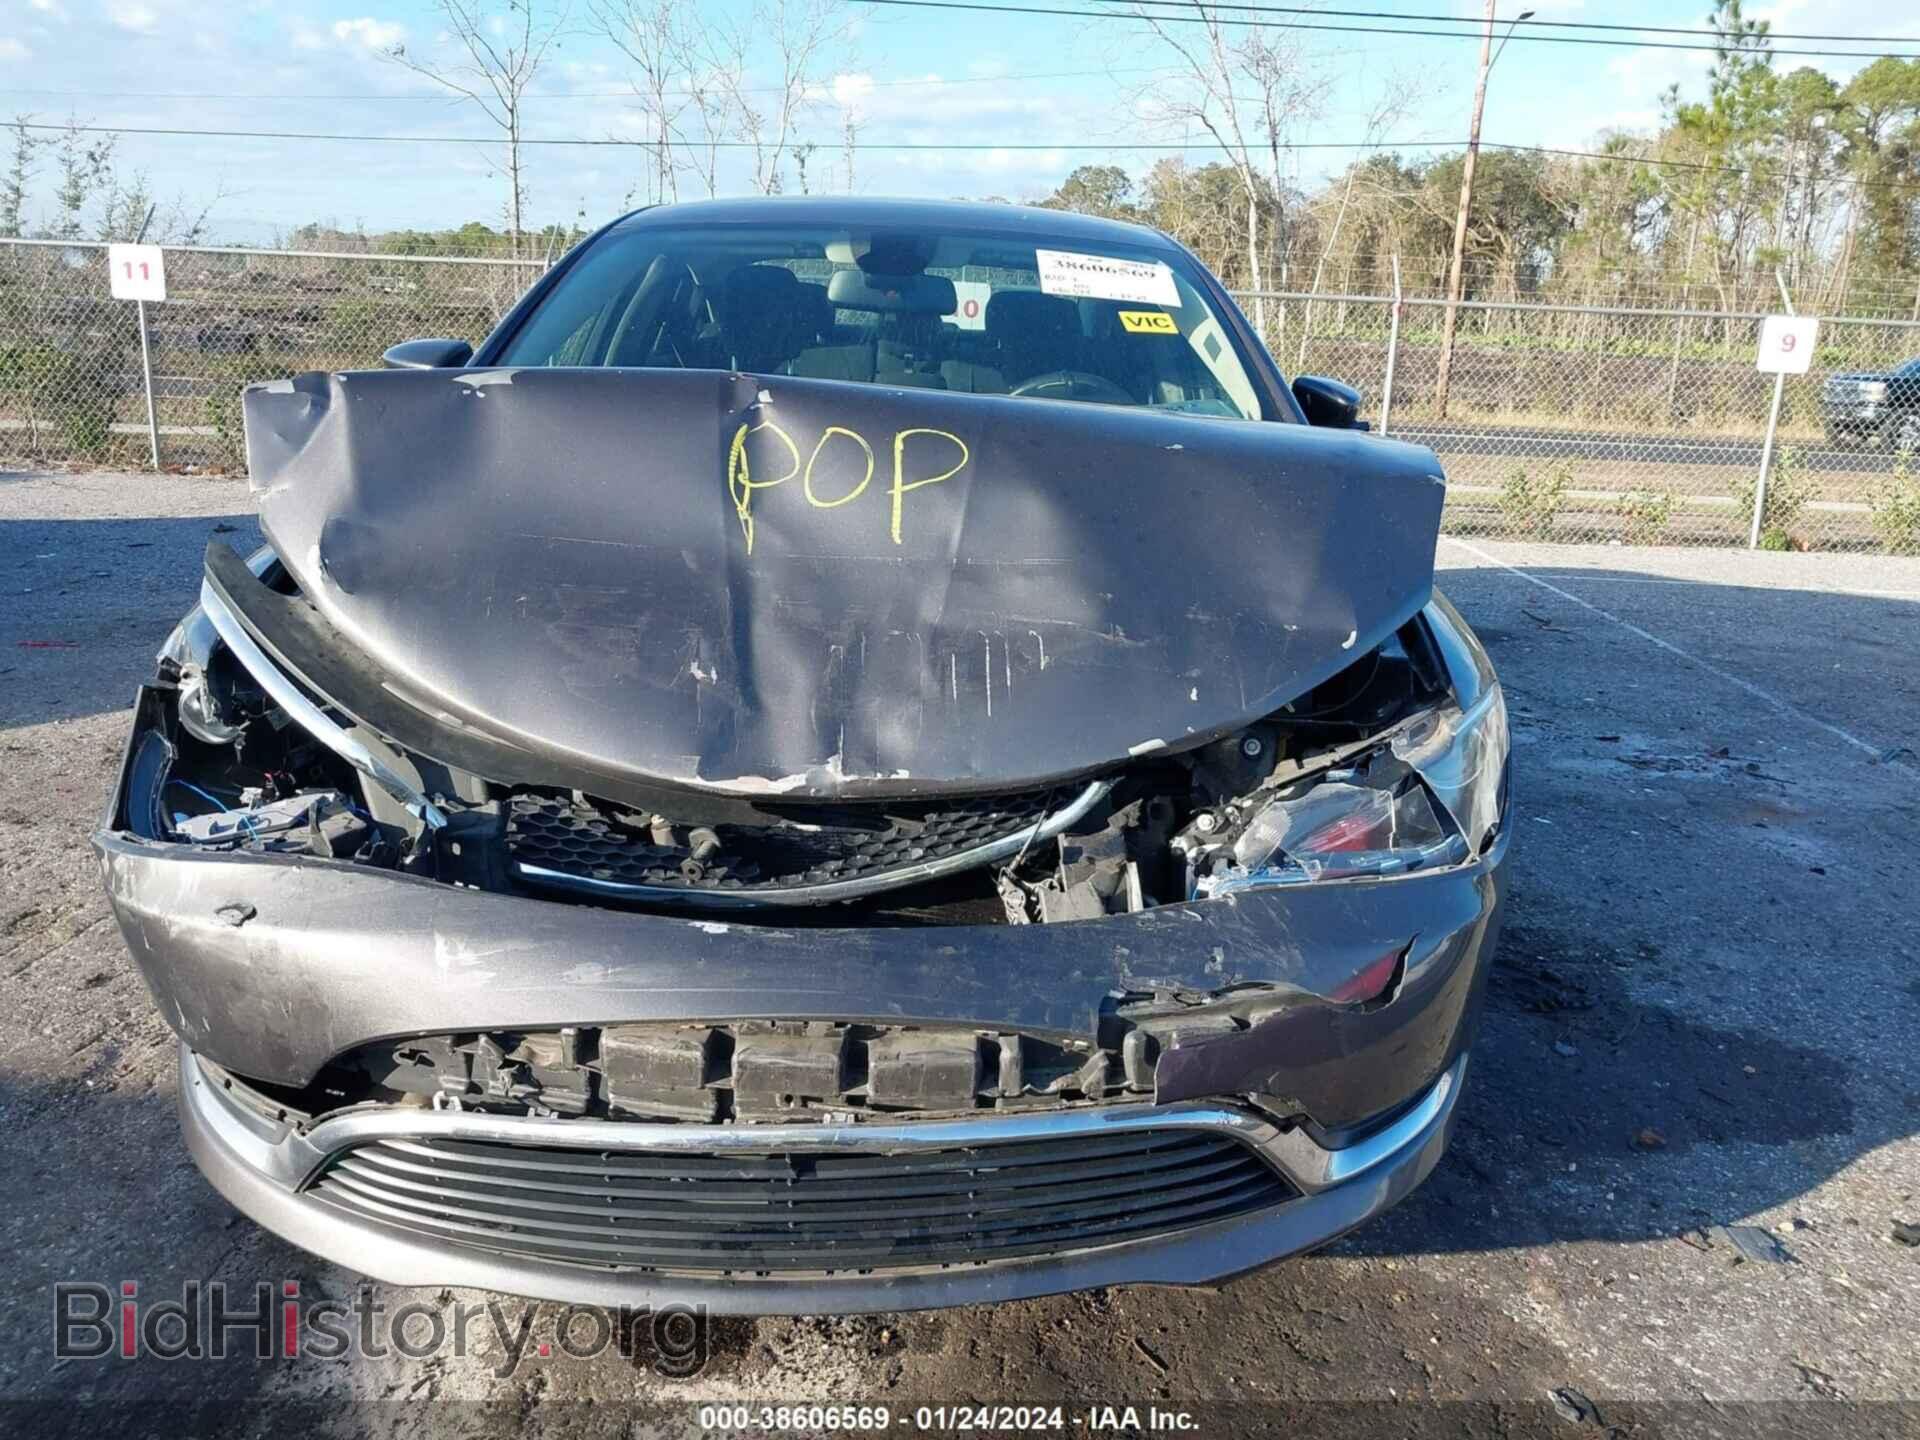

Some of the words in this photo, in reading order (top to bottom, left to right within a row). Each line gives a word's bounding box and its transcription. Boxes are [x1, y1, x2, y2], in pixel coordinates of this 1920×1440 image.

[122, 262, 149, 280] 11
[1125, 316, 1171, 329] VIC
[1781, 334, 1796, 352] 9
[728, 419, 969, 556] POP
